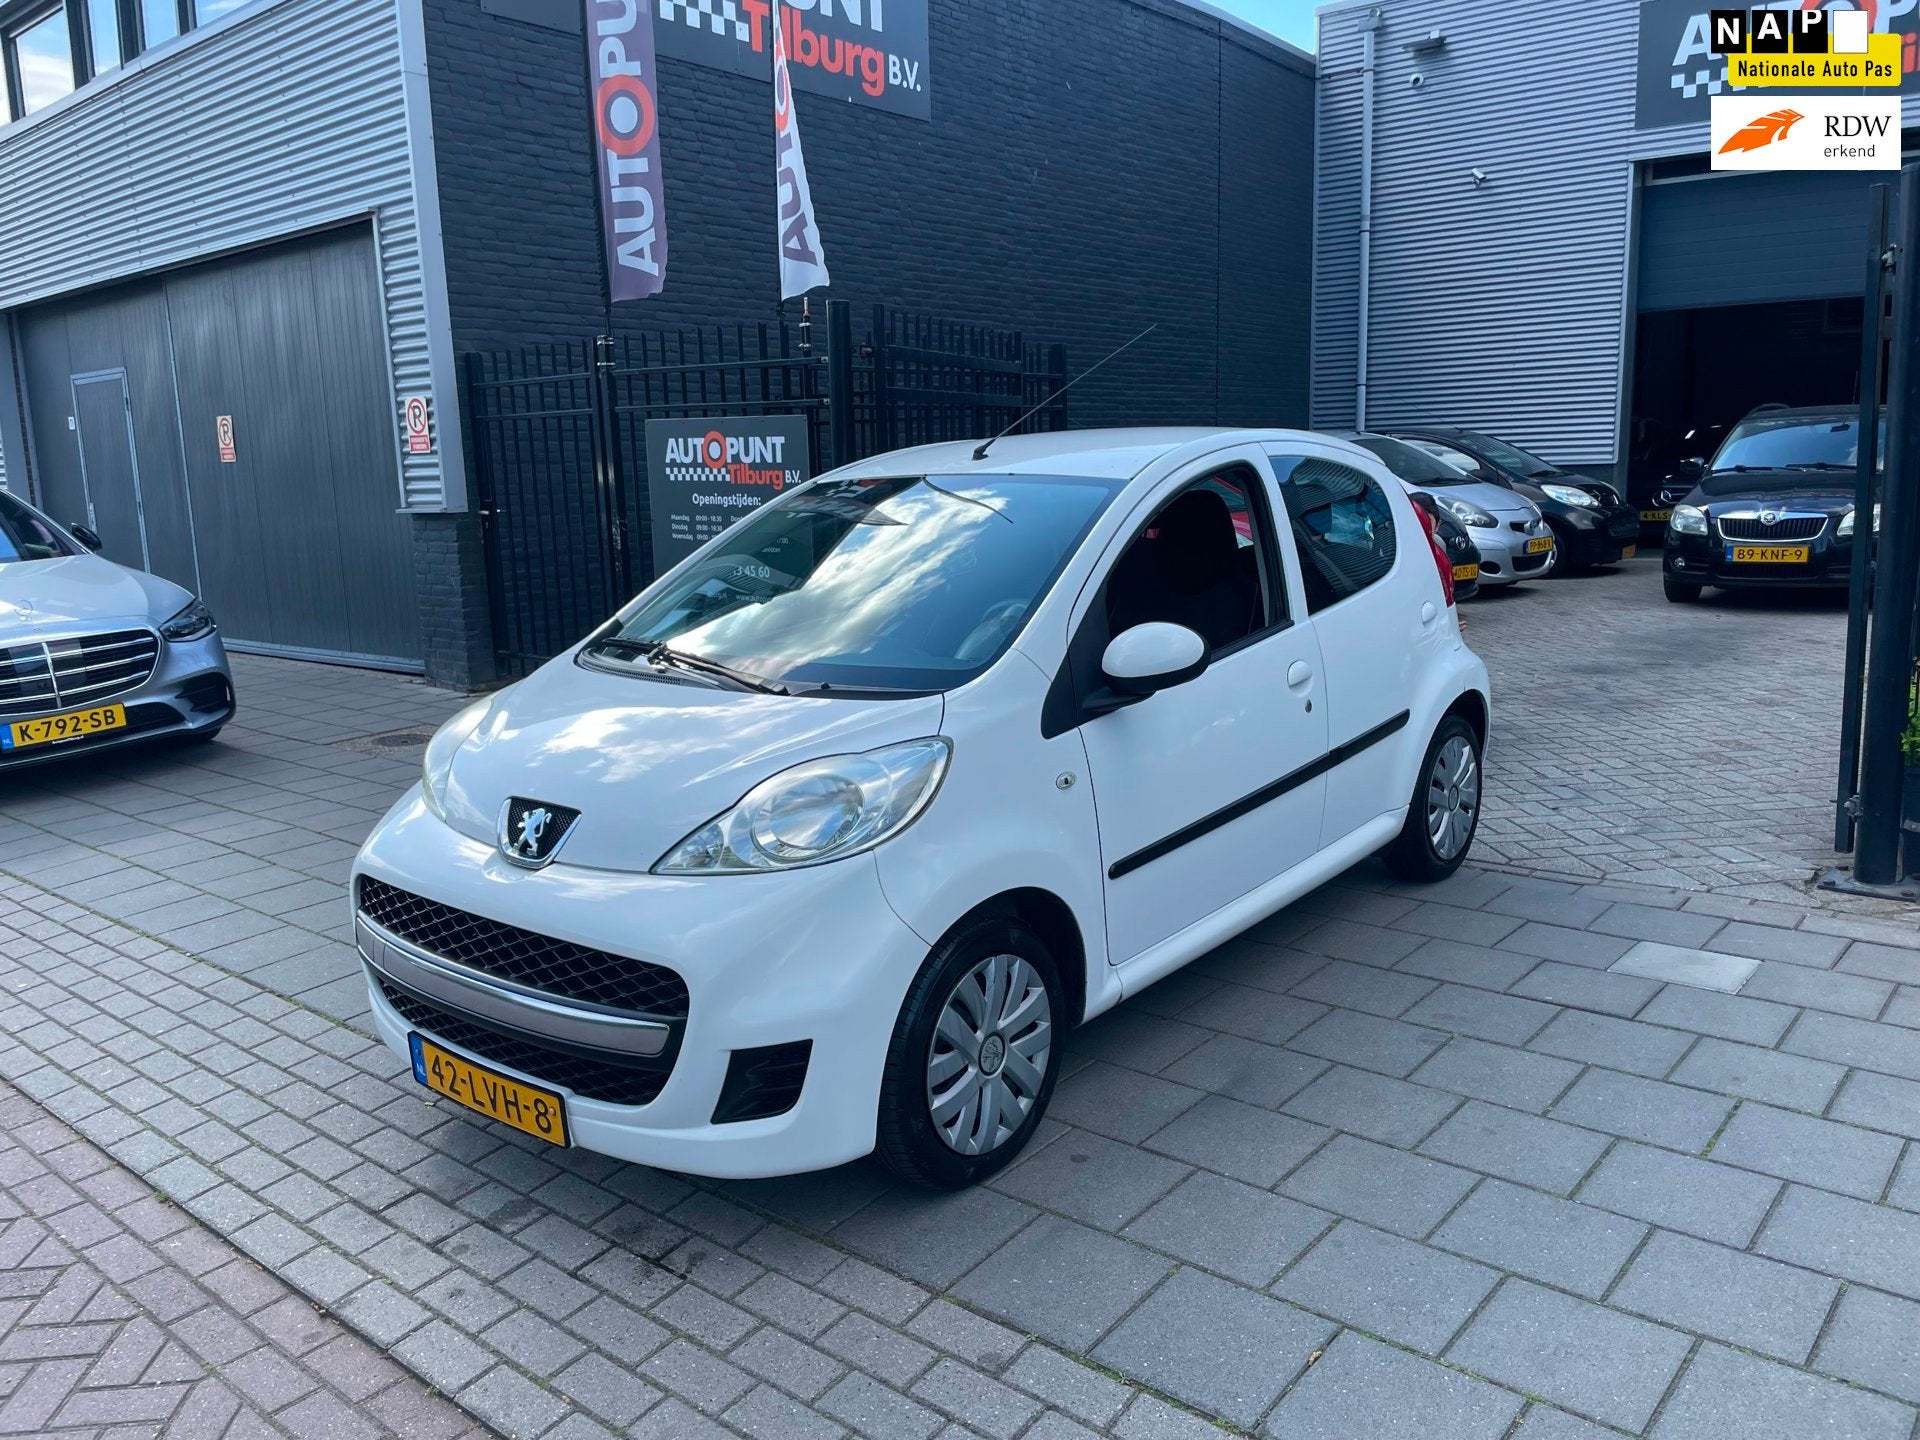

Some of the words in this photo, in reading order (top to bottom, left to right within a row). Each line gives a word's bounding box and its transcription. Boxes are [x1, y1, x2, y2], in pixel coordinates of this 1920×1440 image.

[742, 0, 885, 97] Tlburg
[888, 53, 922, 92] B.V.
[774, 30, 819, 267] AUTO
[665, 430, 785, 469] AUTOPUNT
[728, 464, 784, 490] Tilburg
[785, 470, 802, 484] B.V.
[692, 493, 762, 508] Openingstijden:
[671, 514, 690, 522] Maandag
[1642, 511, 1672, 520] 4-KLS-
[671, 523, 688, 531] Dinsdag
[672, 533, 693, 541] Woensdag
[1737, 549, 1803, 560] 89-KNF-9
[744, 565, 756, 577] 45
[758, 566, 771, 578] 60
[19, 709, 116, 742] K-792-SB
[416, 1063, 426, 1076] NL
[431, 1054, 553, 1134] 42-LVH-8
